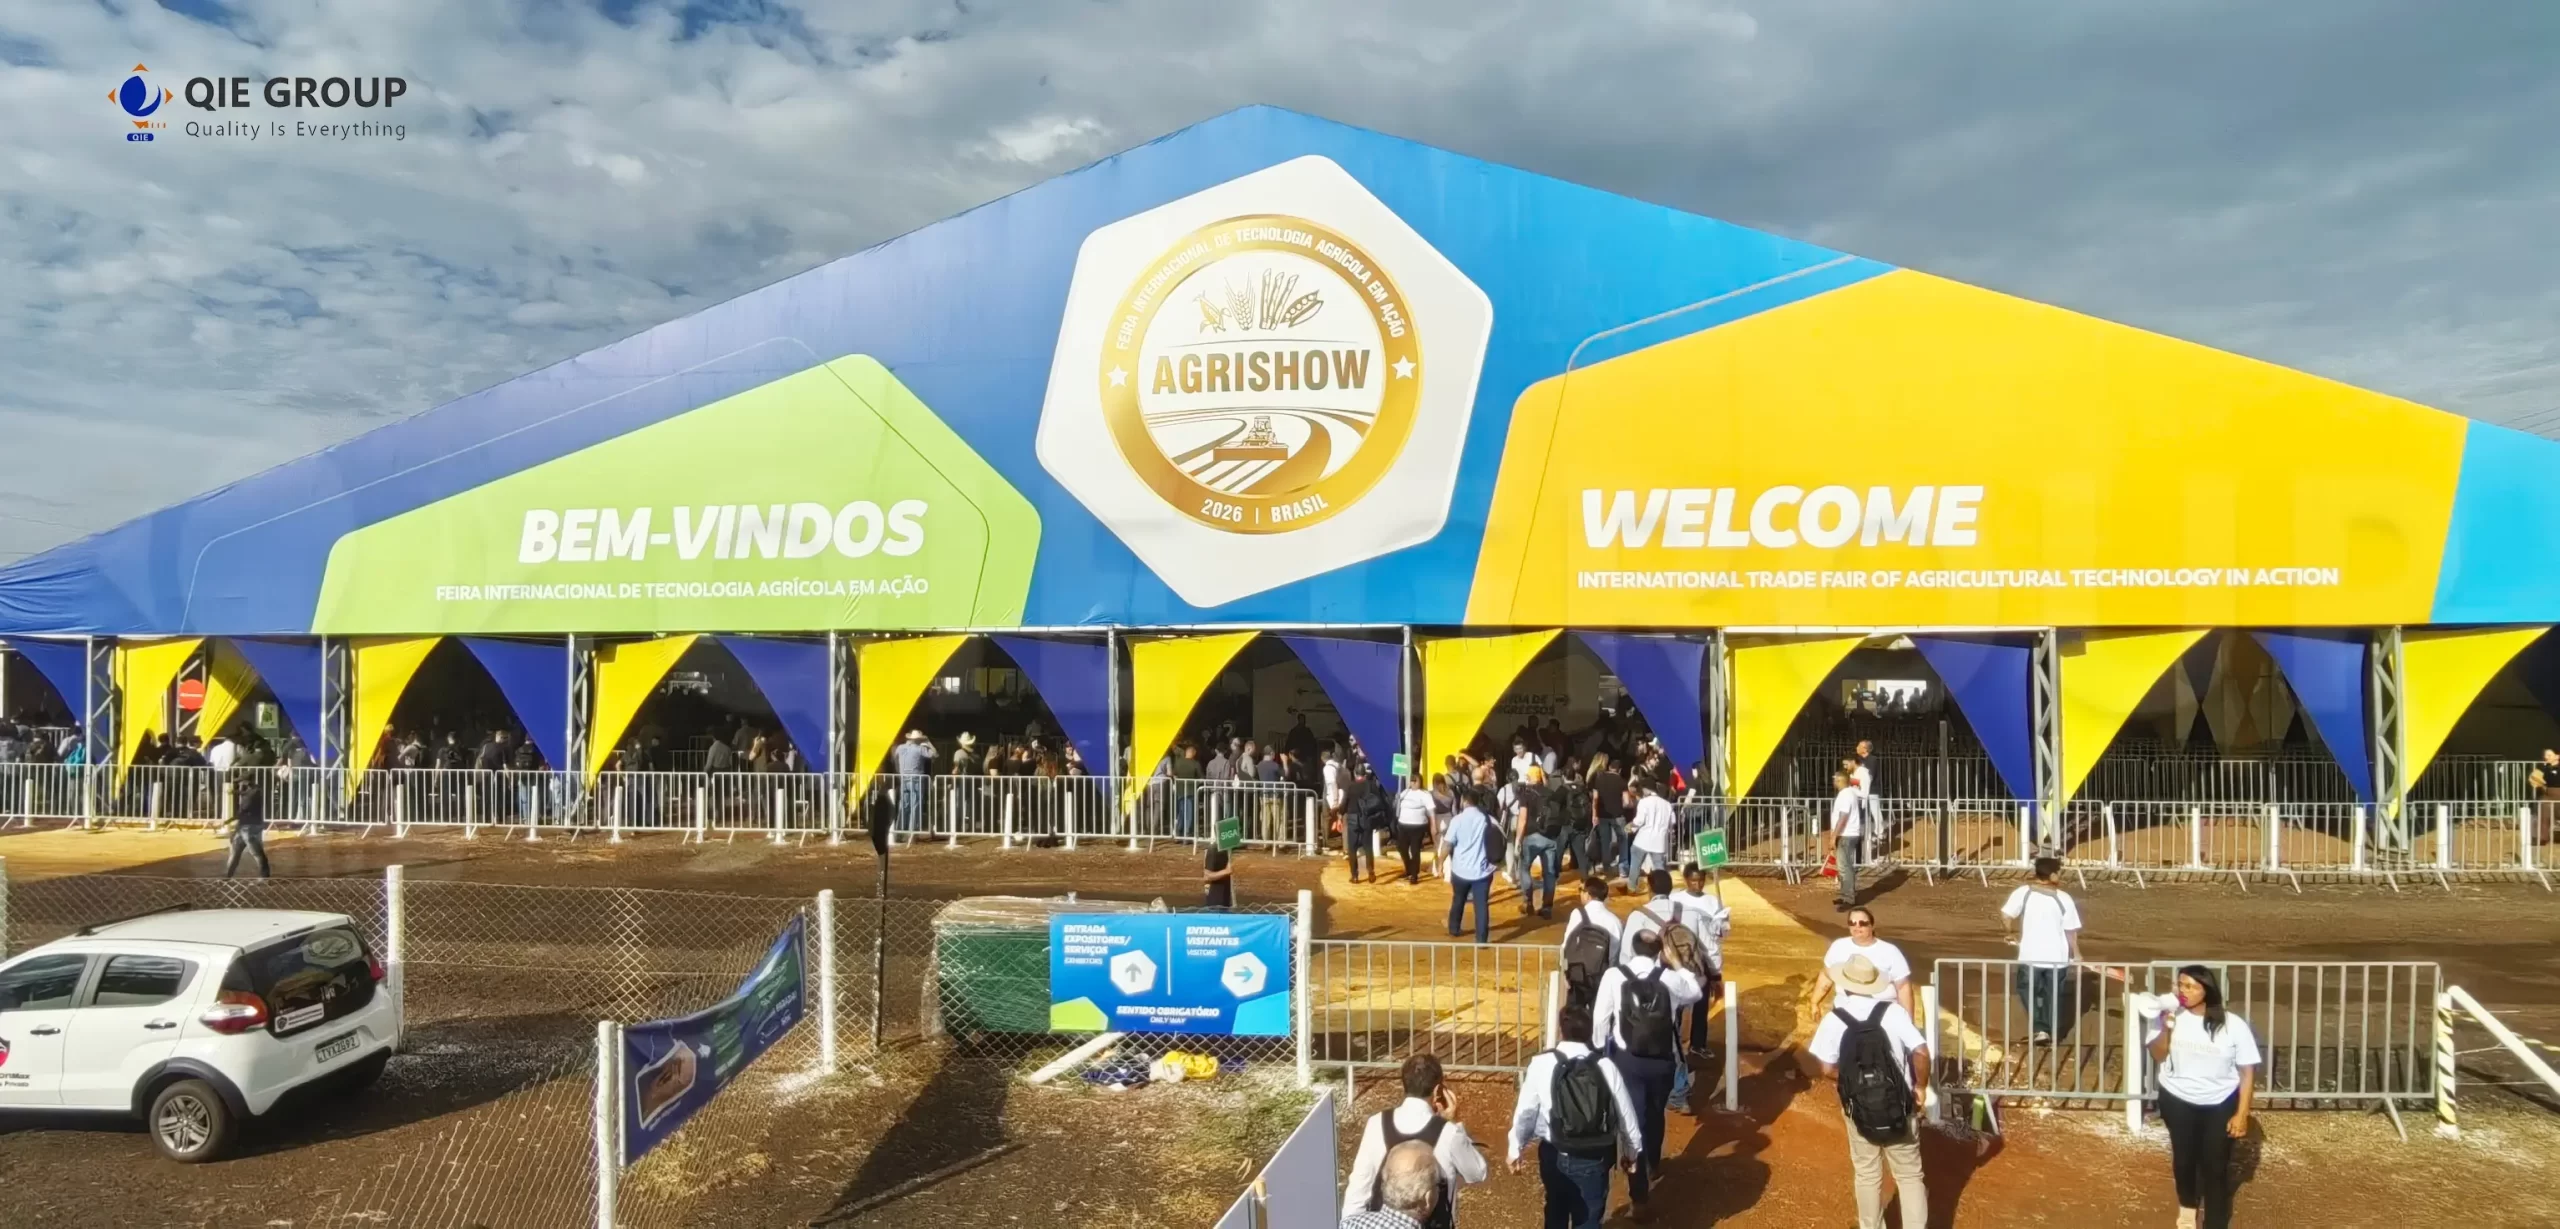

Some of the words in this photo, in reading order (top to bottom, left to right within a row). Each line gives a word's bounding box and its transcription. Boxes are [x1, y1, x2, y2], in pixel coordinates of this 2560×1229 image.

[1116, 314, 1139, 350] FEIRA
[1132, 240, 1212, 314] INTERNACIONAL
[1214, 231, 1231, 247] DE
[1236, 227, 1313, 248] TECNOLOGIA
[1315, 239, 1372, 284] AGRÍCOLA
[1367, 280, 1389, 303] EM
[1380, 302, 1406, 338] AÇÃO
[1152, 349, 1370, 395] AGRISHOW
[1201, 499, 1243, 522] 2026
[1270, 493, 1329, 523] BRASIL
[1582, 485, 1985, 549] WELCOME
[518, 500, 929, 564] BEM-VINDOS
[1578, 571, 1743, 588] INTERNATIONAL
[1747, 571, 1816, 588] TRADE
[1820, 571, 1867, 588] FAIR
[1871, 571, 1901, 588] OF
[1904, 570, 2067, 587] AGRICULTURAL
[2070, 568, 2223, 586] TECHNOLOGY
[2226, 569, 2250, 585] IN
[2254, 568, 2339, 585] ACTION
[436, 585, 482, 601] FEIRA
[484, 583, 616, 600] INTERNACIONAL
[619, 583, 641, 598] DE
[646, 581, 755, 598] TECNOLOGIA
[758, 577, 846, 597] AGRÍCOLA
[849, 579, 875, 595] EM
[878, 575, 928, 598] AÇÃO
[1220, 828, 1238, 841] SIGA
[1701, 841, 1724, 857] SIGA
[1063, 924, 1106, 934] ENTRADA
[1186, 926, 1230, 936] ENTRADA
[1063, 935, 1132, 946] EXPOSITORES/
[1186, 937, 1240, 947] VISITANTES
[1063, 945, 1109, 956] SERVIÇOS
[1186, 949, 1217, 957] VISITORS
[1116, 1005, 1156, 1016] SENTIDO
[1157, 1005, 1220, 1018] OBRIGATÓRIO
[1150, 1016, 1168, 1024] ONLY
[1169, 1017, 1187, 1025] WAY
